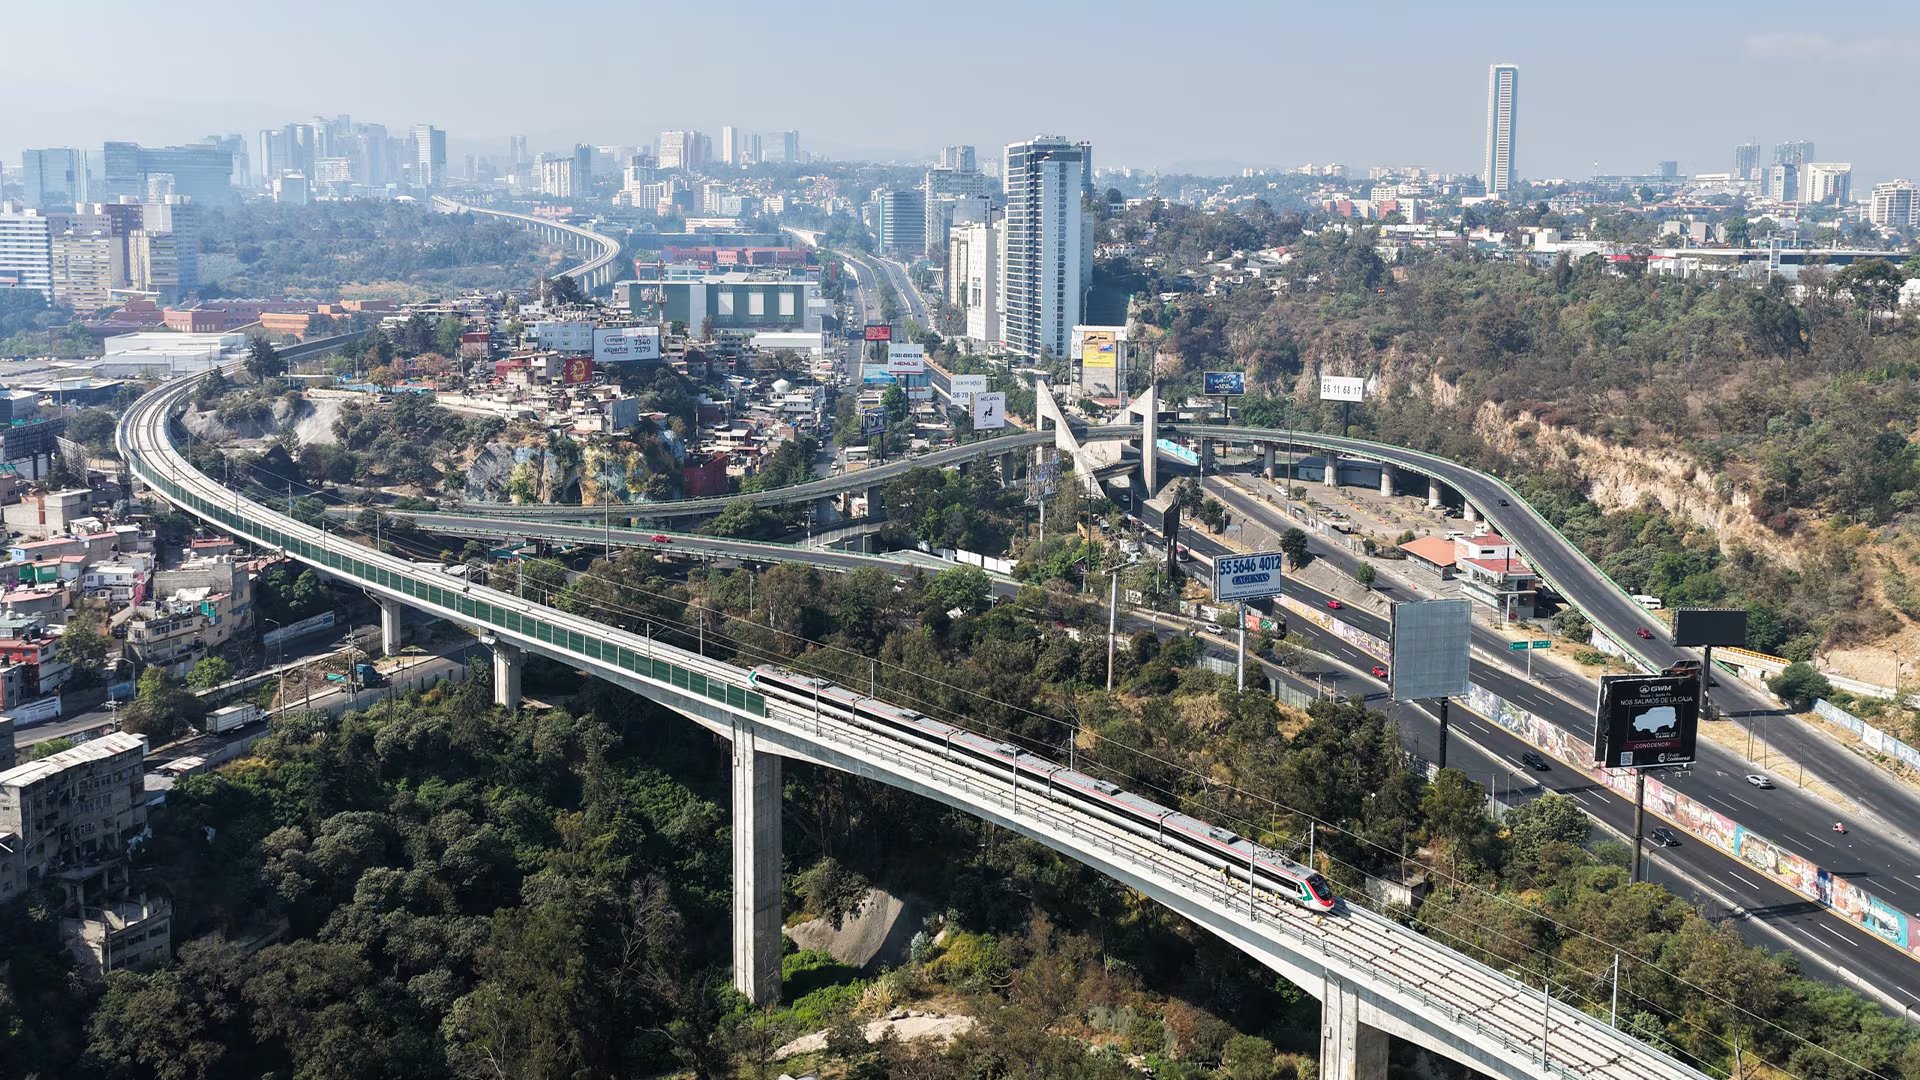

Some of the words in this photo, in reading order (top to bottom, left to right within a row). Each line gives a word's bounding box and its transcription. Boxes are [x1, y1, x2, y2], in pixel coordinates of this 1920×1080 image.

[1334, 385, 1340, 394] 11
[1354, 386, 1361, 395] 17
[1220, 560, 1232, 576] 55
[1233, 558, 1257, 574] 5646
[1259, 555, 1281, 571] 4012
[1233, 574, 1269, 584] LAGUNAS
